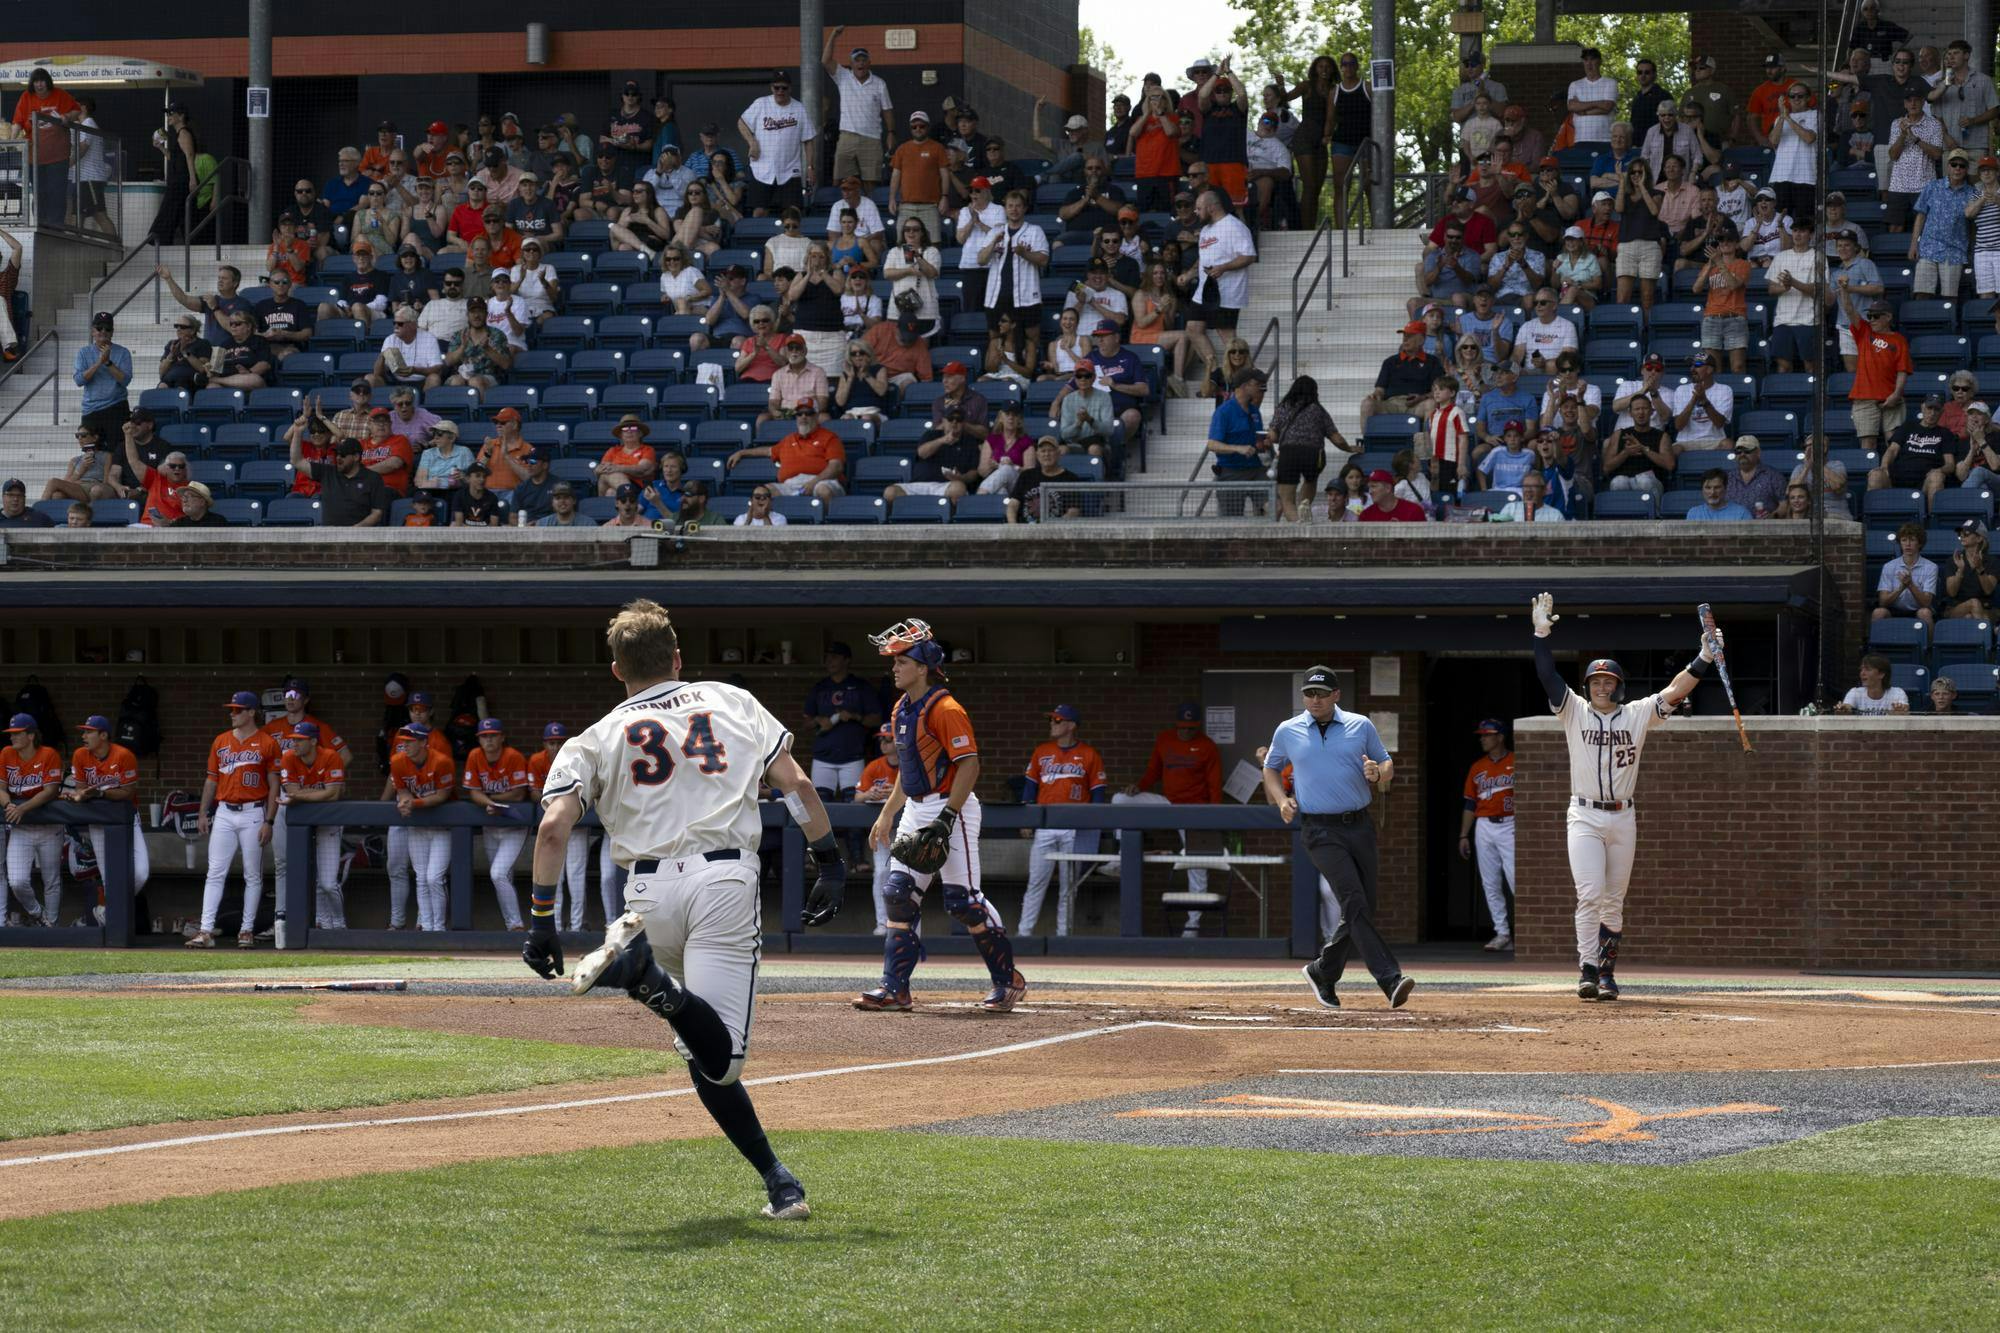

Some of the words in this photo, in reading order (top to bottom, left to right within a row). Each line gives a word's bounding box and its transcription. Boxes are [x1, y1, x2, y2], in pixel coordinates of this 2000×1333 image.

[63, 68, 88, 77] Cream
[91, 68, 99, 77] of
[101, 68, 113, 76] the
[116, 67, 142, 76] Future
[763, 117, 798, 131] Virginia
[264, 312, 294, 325] VIRGINIA
[1907, 433, 1942, 448] Virginia
[1908, 446, 1936, 454] BASEBALL
[1308, 674, 1325, 682] ACC
[1581, 730, 1633, 746] VIRGINIA
[624, 712, 729, 787] 34
[217, 744, 263, 774] Tigers
[1616, 747, 1636, 769] 25
[1039, 754, 1086, 784] Tigers
[5, 765, 44, 794] Tigers
[242, 771, 260, 788] 00
[677, 861, 685, 873] V
